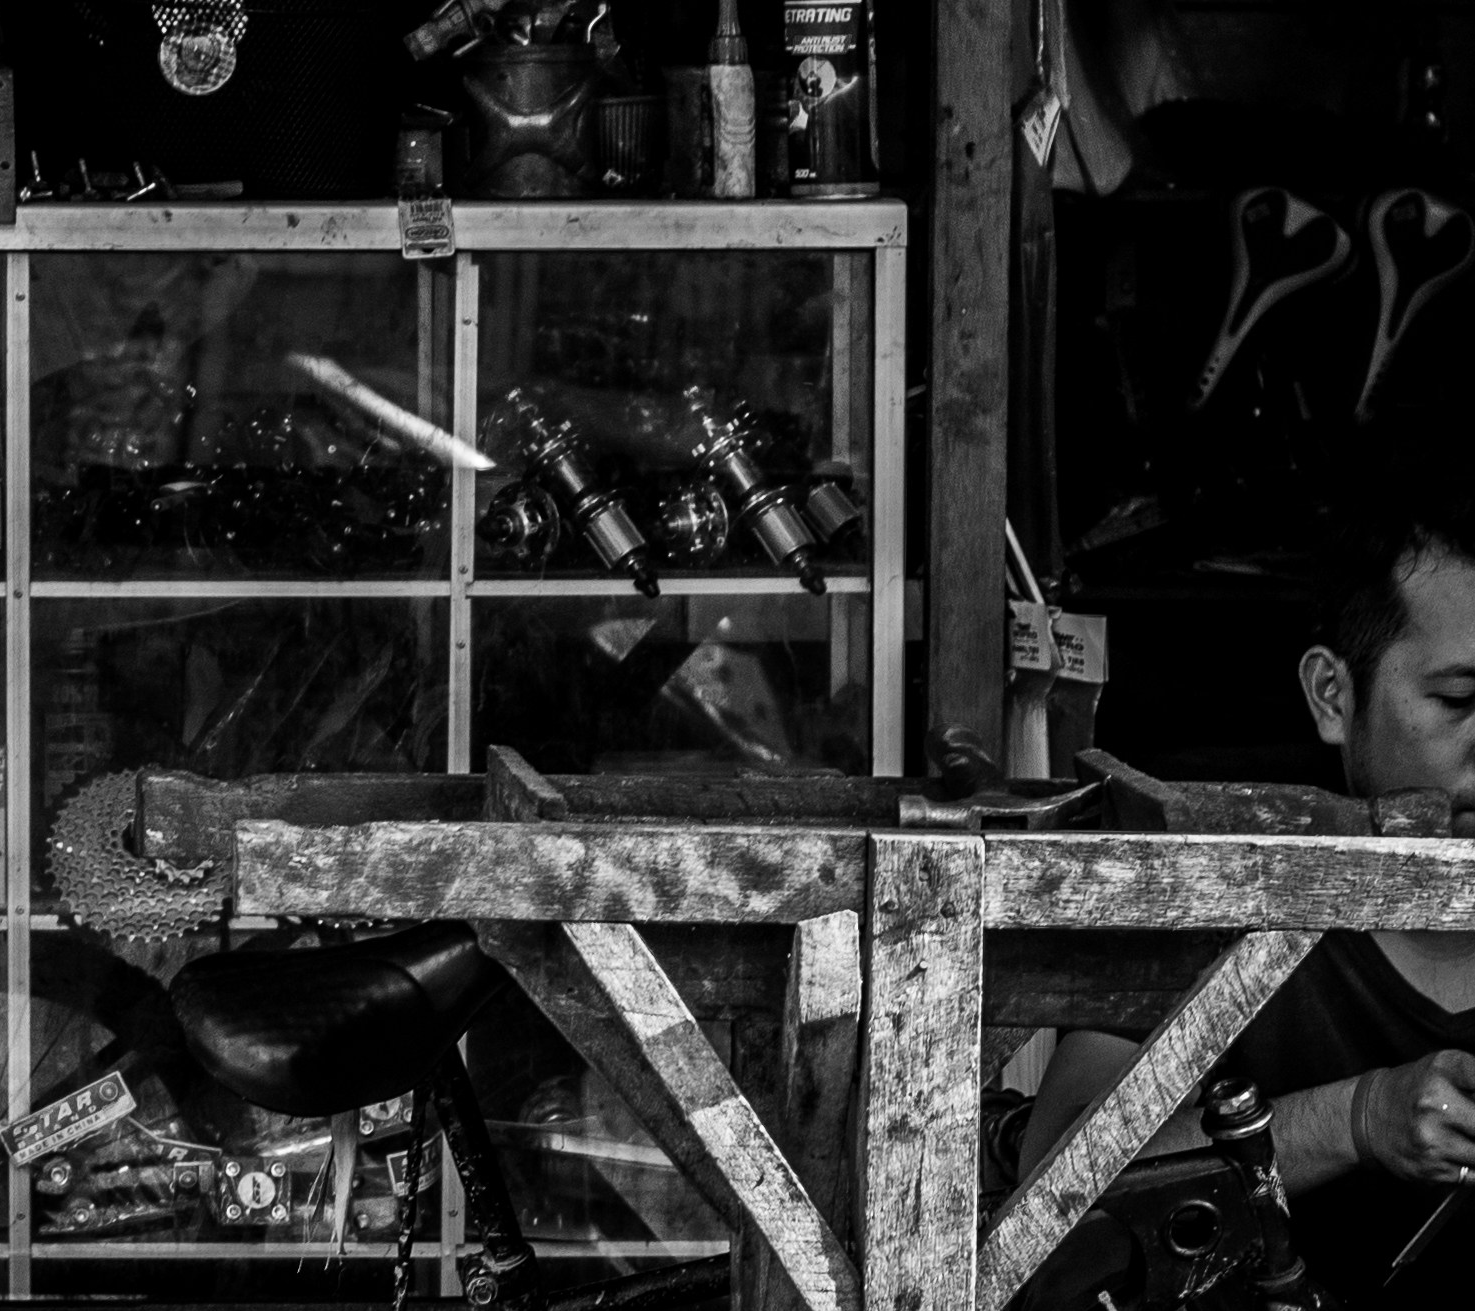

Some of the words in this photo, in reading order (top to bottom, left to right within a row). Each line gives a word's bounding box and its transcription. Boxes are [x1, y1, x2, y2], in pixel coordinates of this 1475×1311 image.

[12, 1090, 92, 1136] STAR
[17, 1135, 49, 1160] MADE
[52, 1130, 64, 1144] IN
[66, 1114, 101, 1137] CHINA
